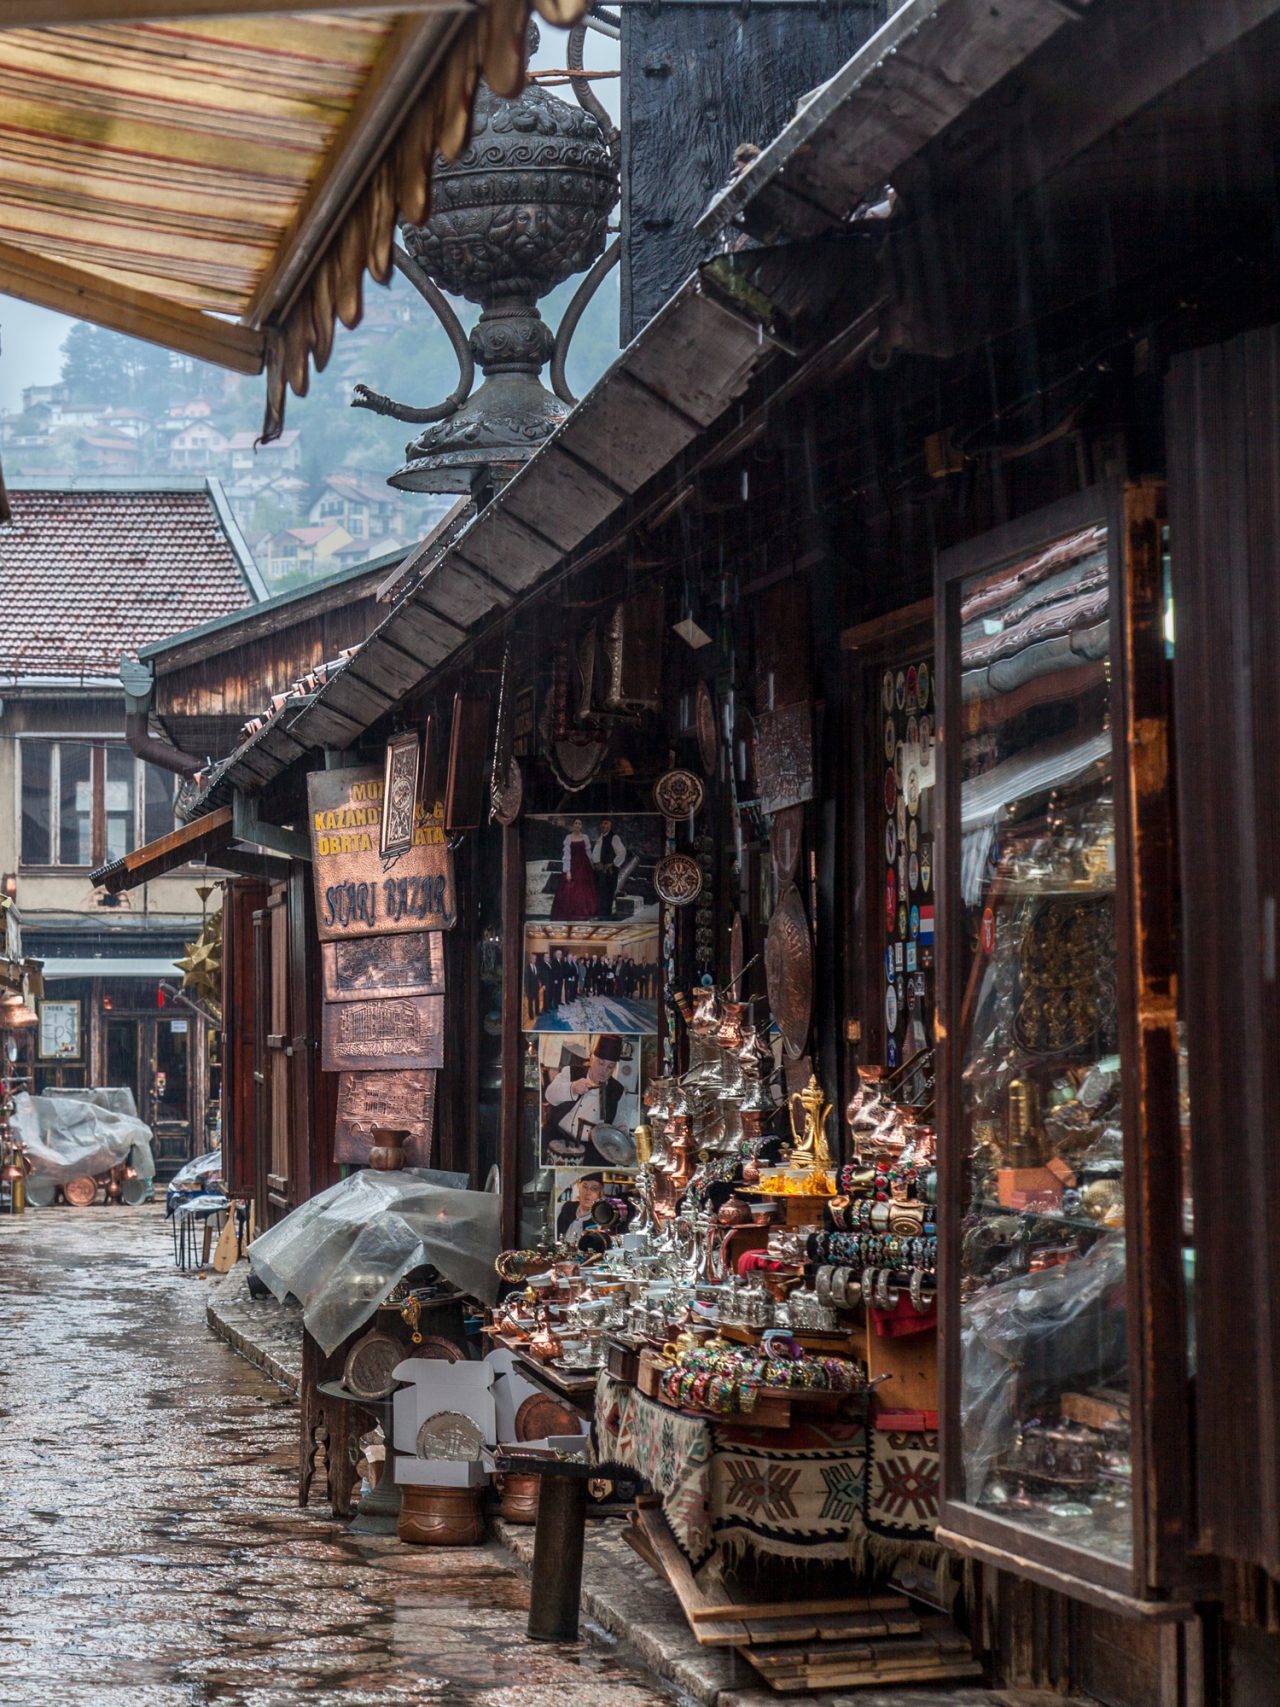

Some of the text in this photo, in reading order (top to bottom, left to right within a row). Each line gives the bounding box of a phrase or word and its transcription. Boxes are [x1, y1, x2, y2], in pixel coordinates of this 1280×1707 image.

[319, 834, 371, 857] OBRTA
[325, 874, 452, 928] STARI BAZAR
